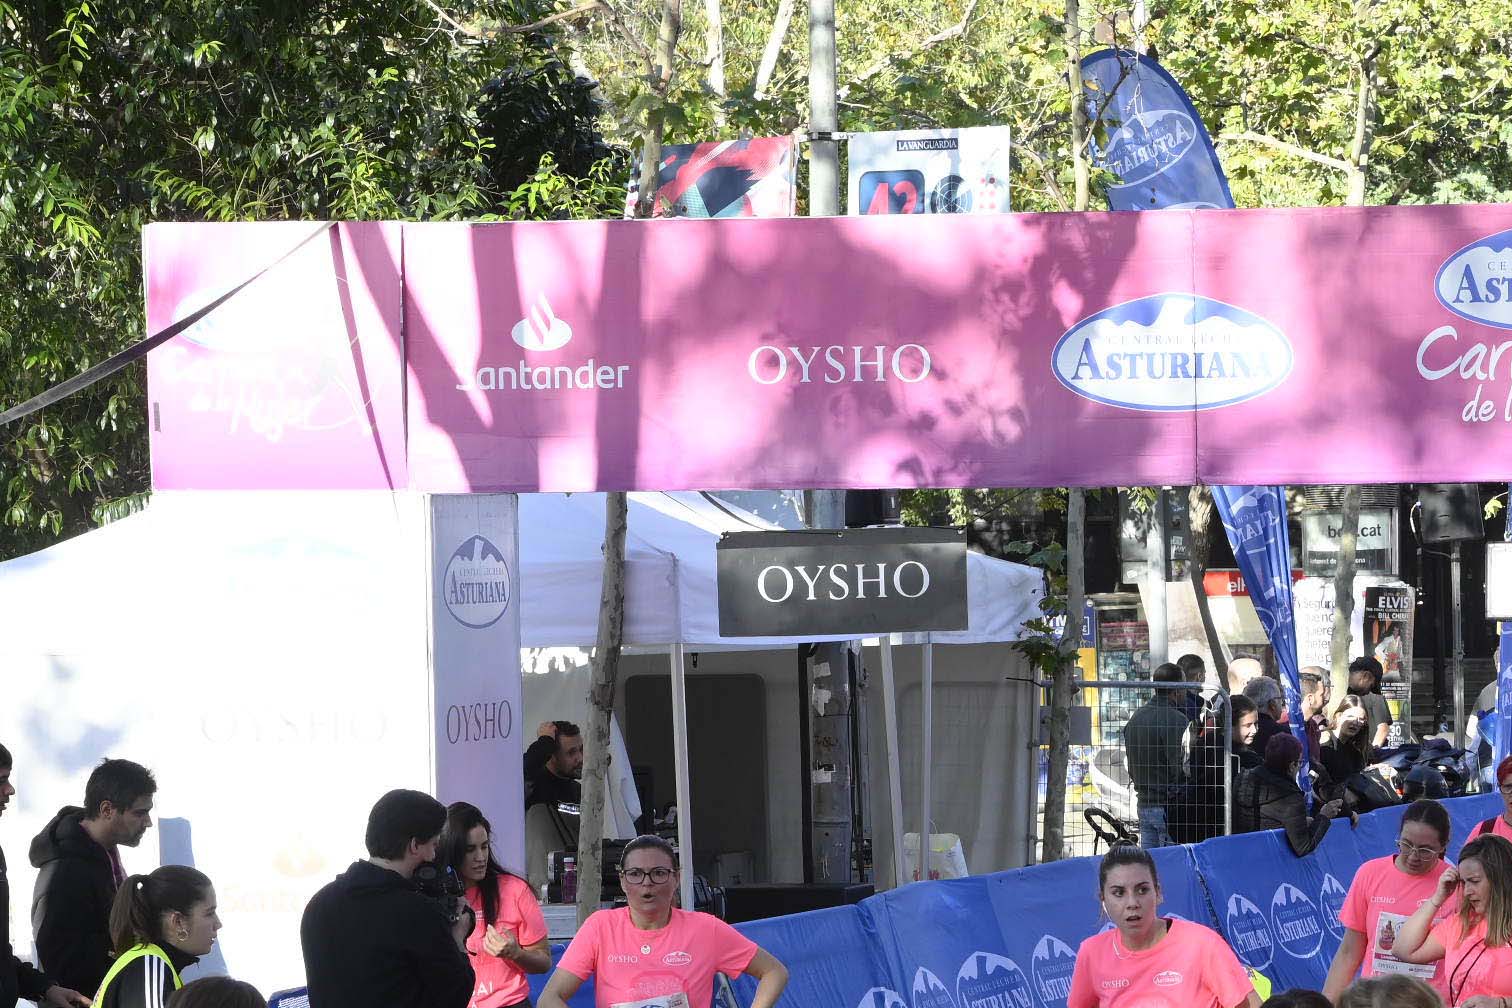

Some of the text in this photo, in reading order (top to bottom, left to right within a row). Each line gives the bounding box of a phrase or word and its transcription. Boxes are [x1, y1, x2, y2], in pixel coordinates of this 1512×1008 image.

[747, 344, 932, 385] OYSHO
[1071, 337, 1274, 381] ASTURIANA
[1462, 383, 1496, 422] de
[449, 571, 507, 605] ASTURIANA
[757, 560, 930, 602] OYSHO
[1379, 596, 1409, 608] ELVIS
[447, 700, 512, 744] OYSHO
[1278, 915, 1322, 943] ASTURIANA
[608, 954, 638, 964] OYSHO
